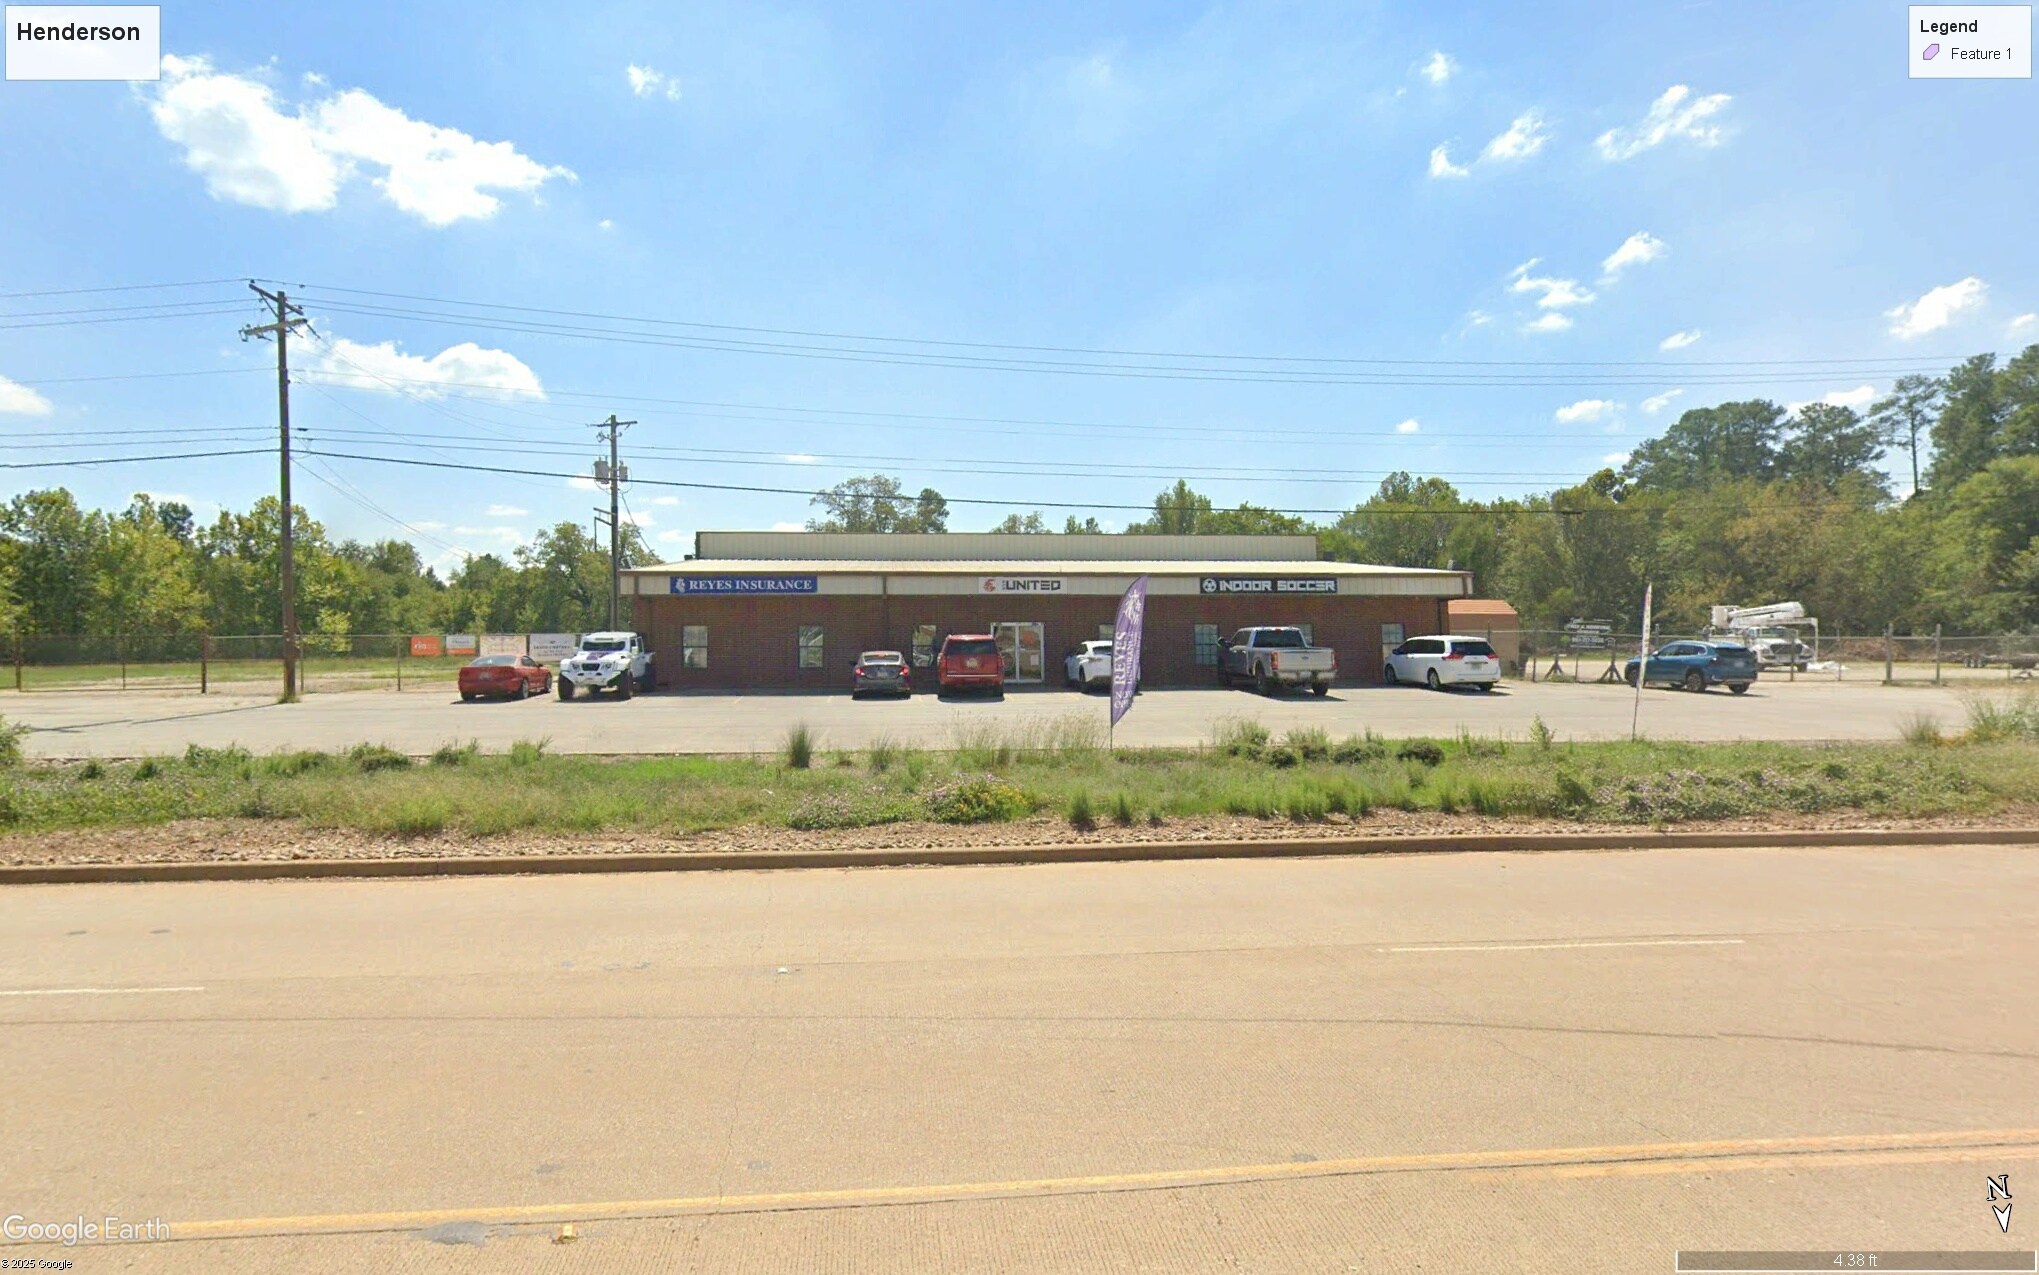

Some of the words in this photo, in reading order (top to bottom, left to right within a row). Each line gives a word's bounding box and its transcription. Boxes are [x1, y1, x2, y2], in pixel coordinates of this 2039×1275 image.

[689, 580, 732, 590] REYES
[735, 580, 812, 590] INSURANCE
[1006, 580, 1061, 591] UNITED
[1219, 580, 1272, 591] INDOOR
[1277, 580, 1336, 591] SOCCER
[1114, 631, 1127, 685] REYES
